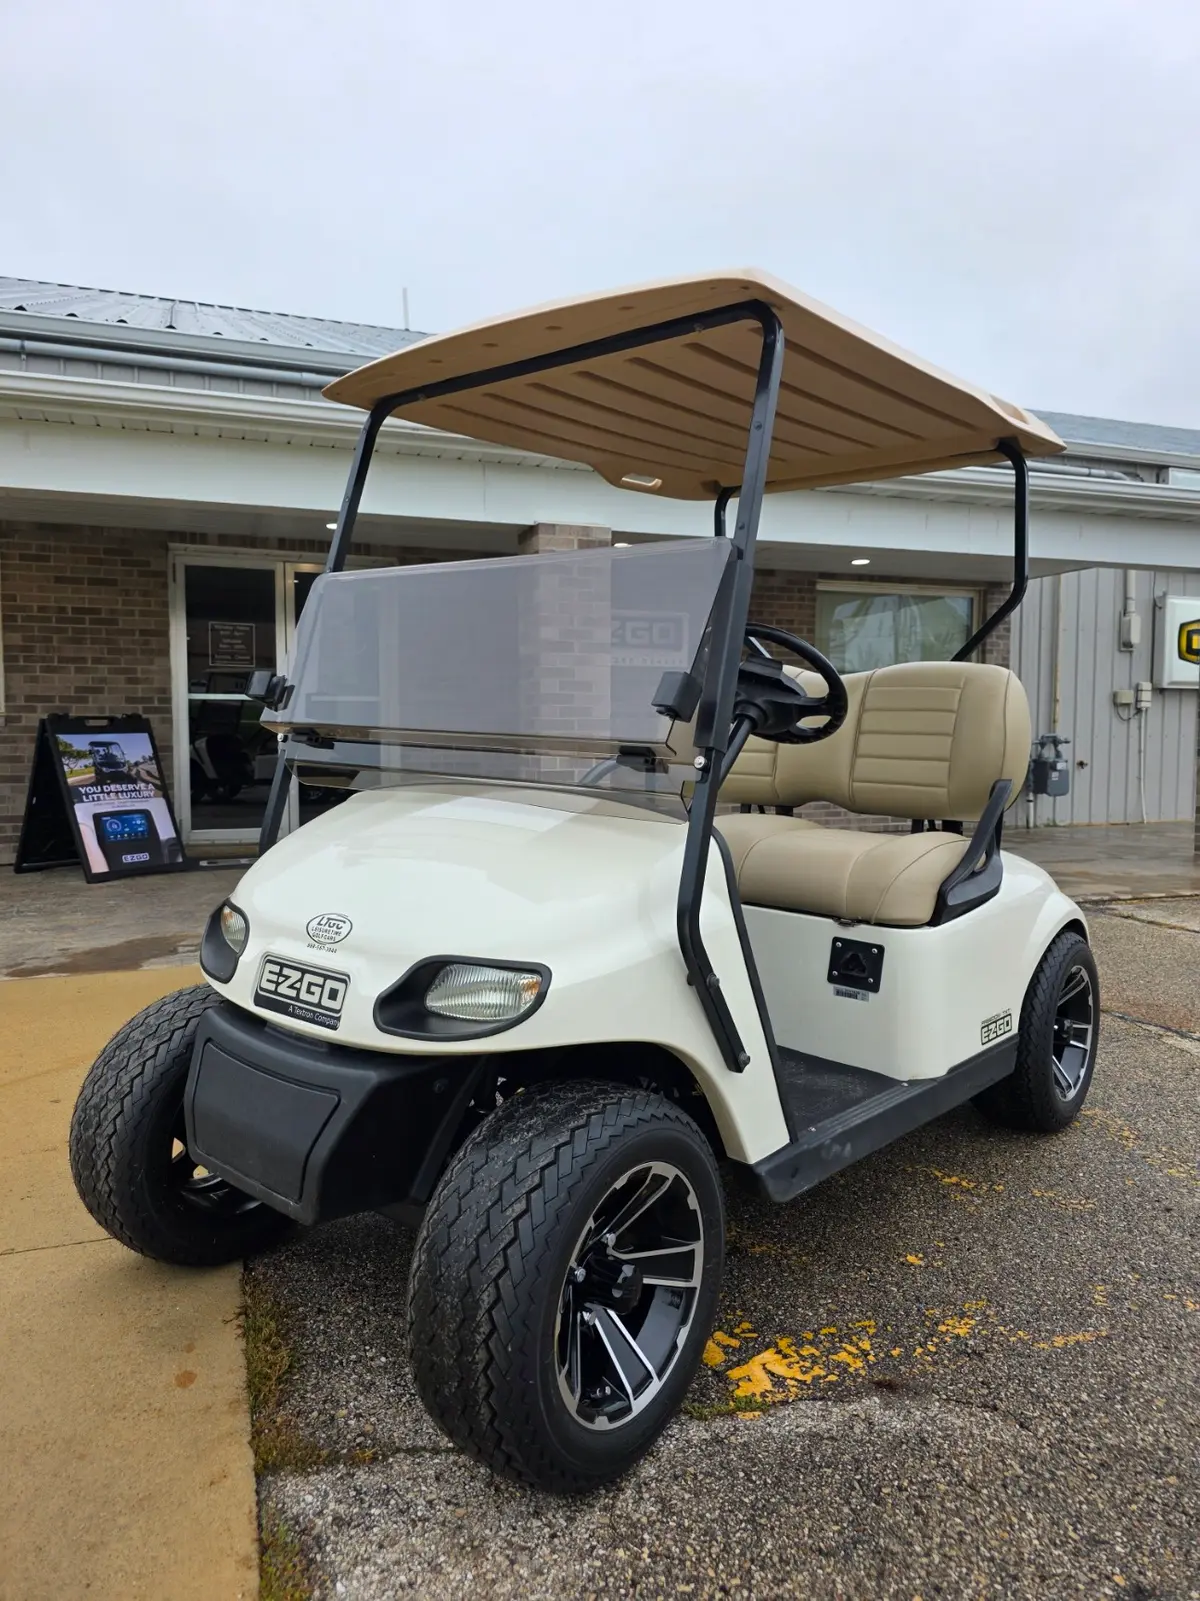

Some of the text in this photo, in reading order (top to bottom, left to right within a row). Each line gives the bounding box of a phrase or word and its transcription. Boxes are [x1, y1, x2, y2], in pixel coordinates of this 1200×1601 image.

[79, 784, 102, 794] YOU
[103, 783, 147, 791] DESERVE
[82, 790, 155, 802] LITTLE LUXURY
[260, 962, 346, 1010] EZGO
[288, 1005, 341, 1028] A Textron Company
[981, 1013, 1012, 1046] EZGO
